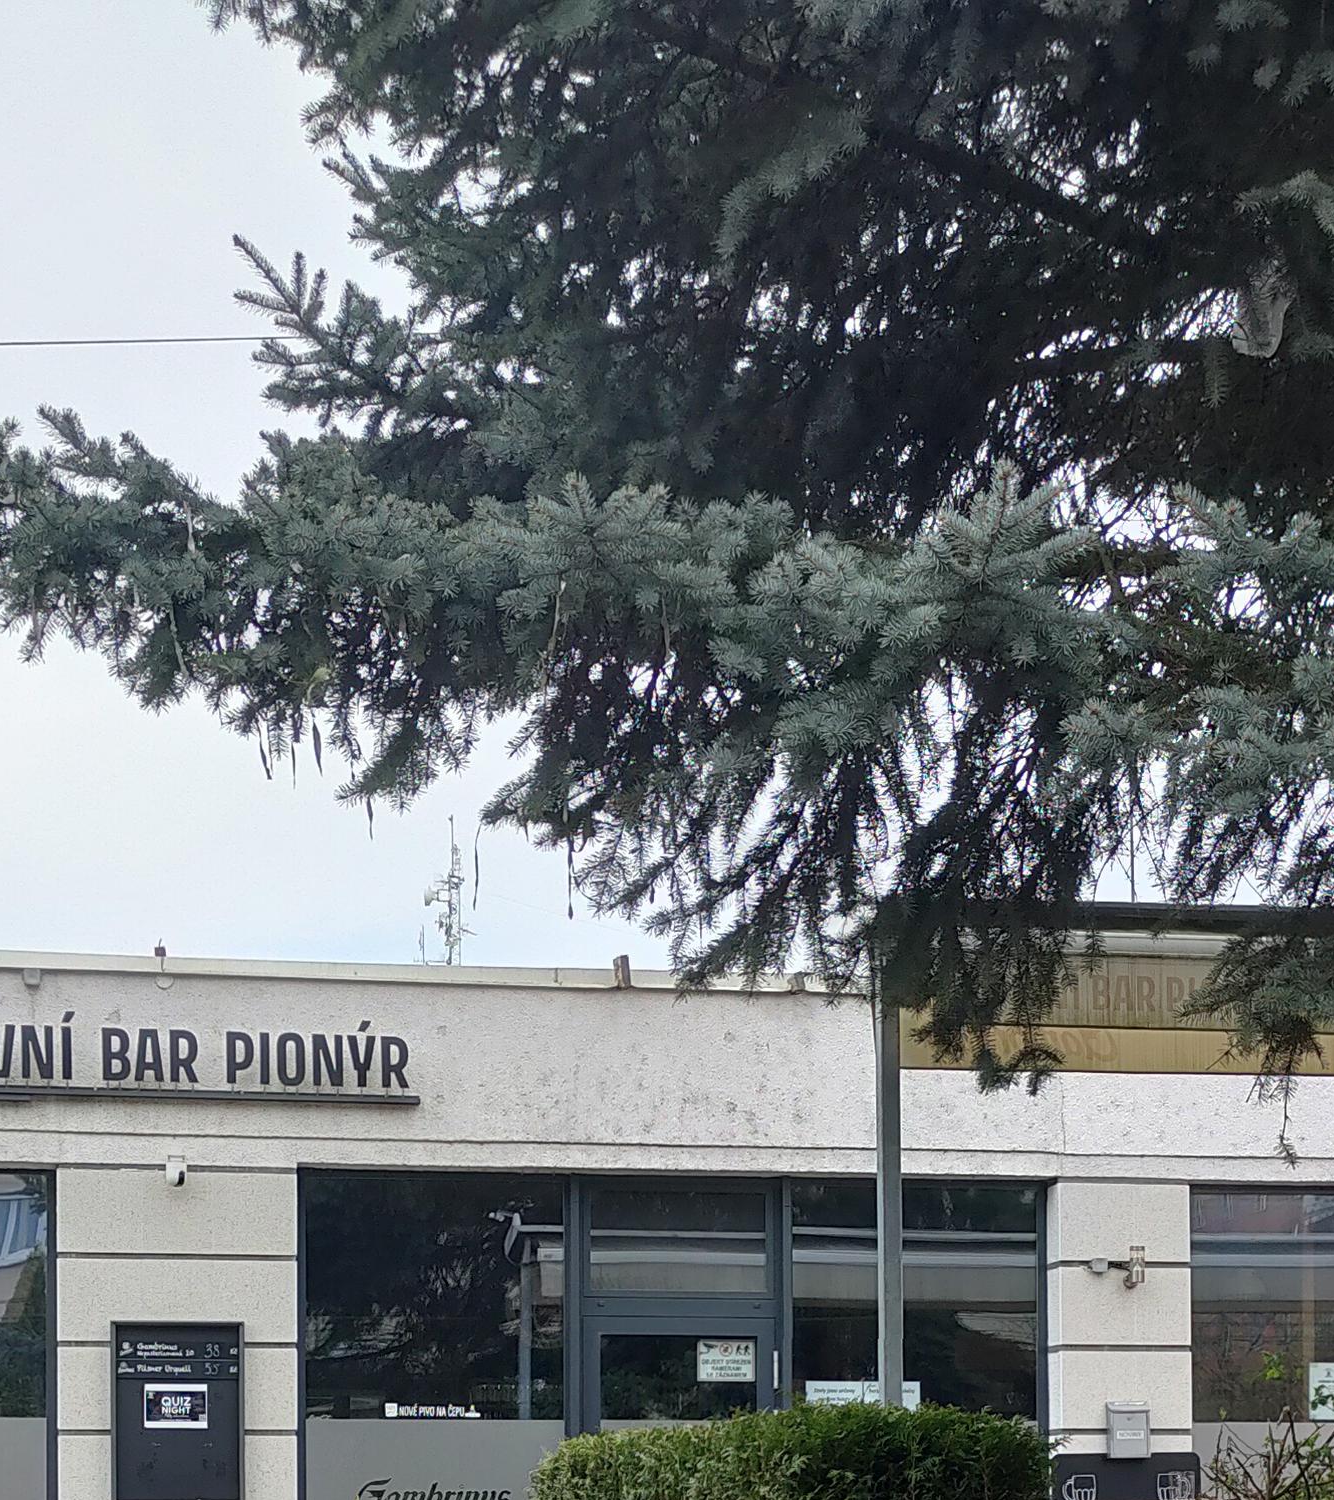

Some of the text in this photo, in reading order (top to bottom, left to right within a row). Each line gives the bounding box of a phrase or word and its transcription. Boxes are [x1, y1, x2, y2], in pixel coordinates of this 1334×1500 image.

[1092, 975, 1156, 1012] BAR
[101, 1027, 199, 1083] BAR
[226, 1021, 409, 1088] PIONÝR
[137, 1342, 178, 1350] Gambrinus
[204, 1343, 220, 1358] 38
[137, 1364, 162, 1373] Pilsner
[165, 1364, 192, 1375] Urquell
[204, 1363, 220, 1375] 55
[161, 1396, 192, 1407] QUIZ
[161, 1406, 192, 1415] NIGHT
[399, 1402, 465, 1417] NOVÉ PIVO NA ČEPU
